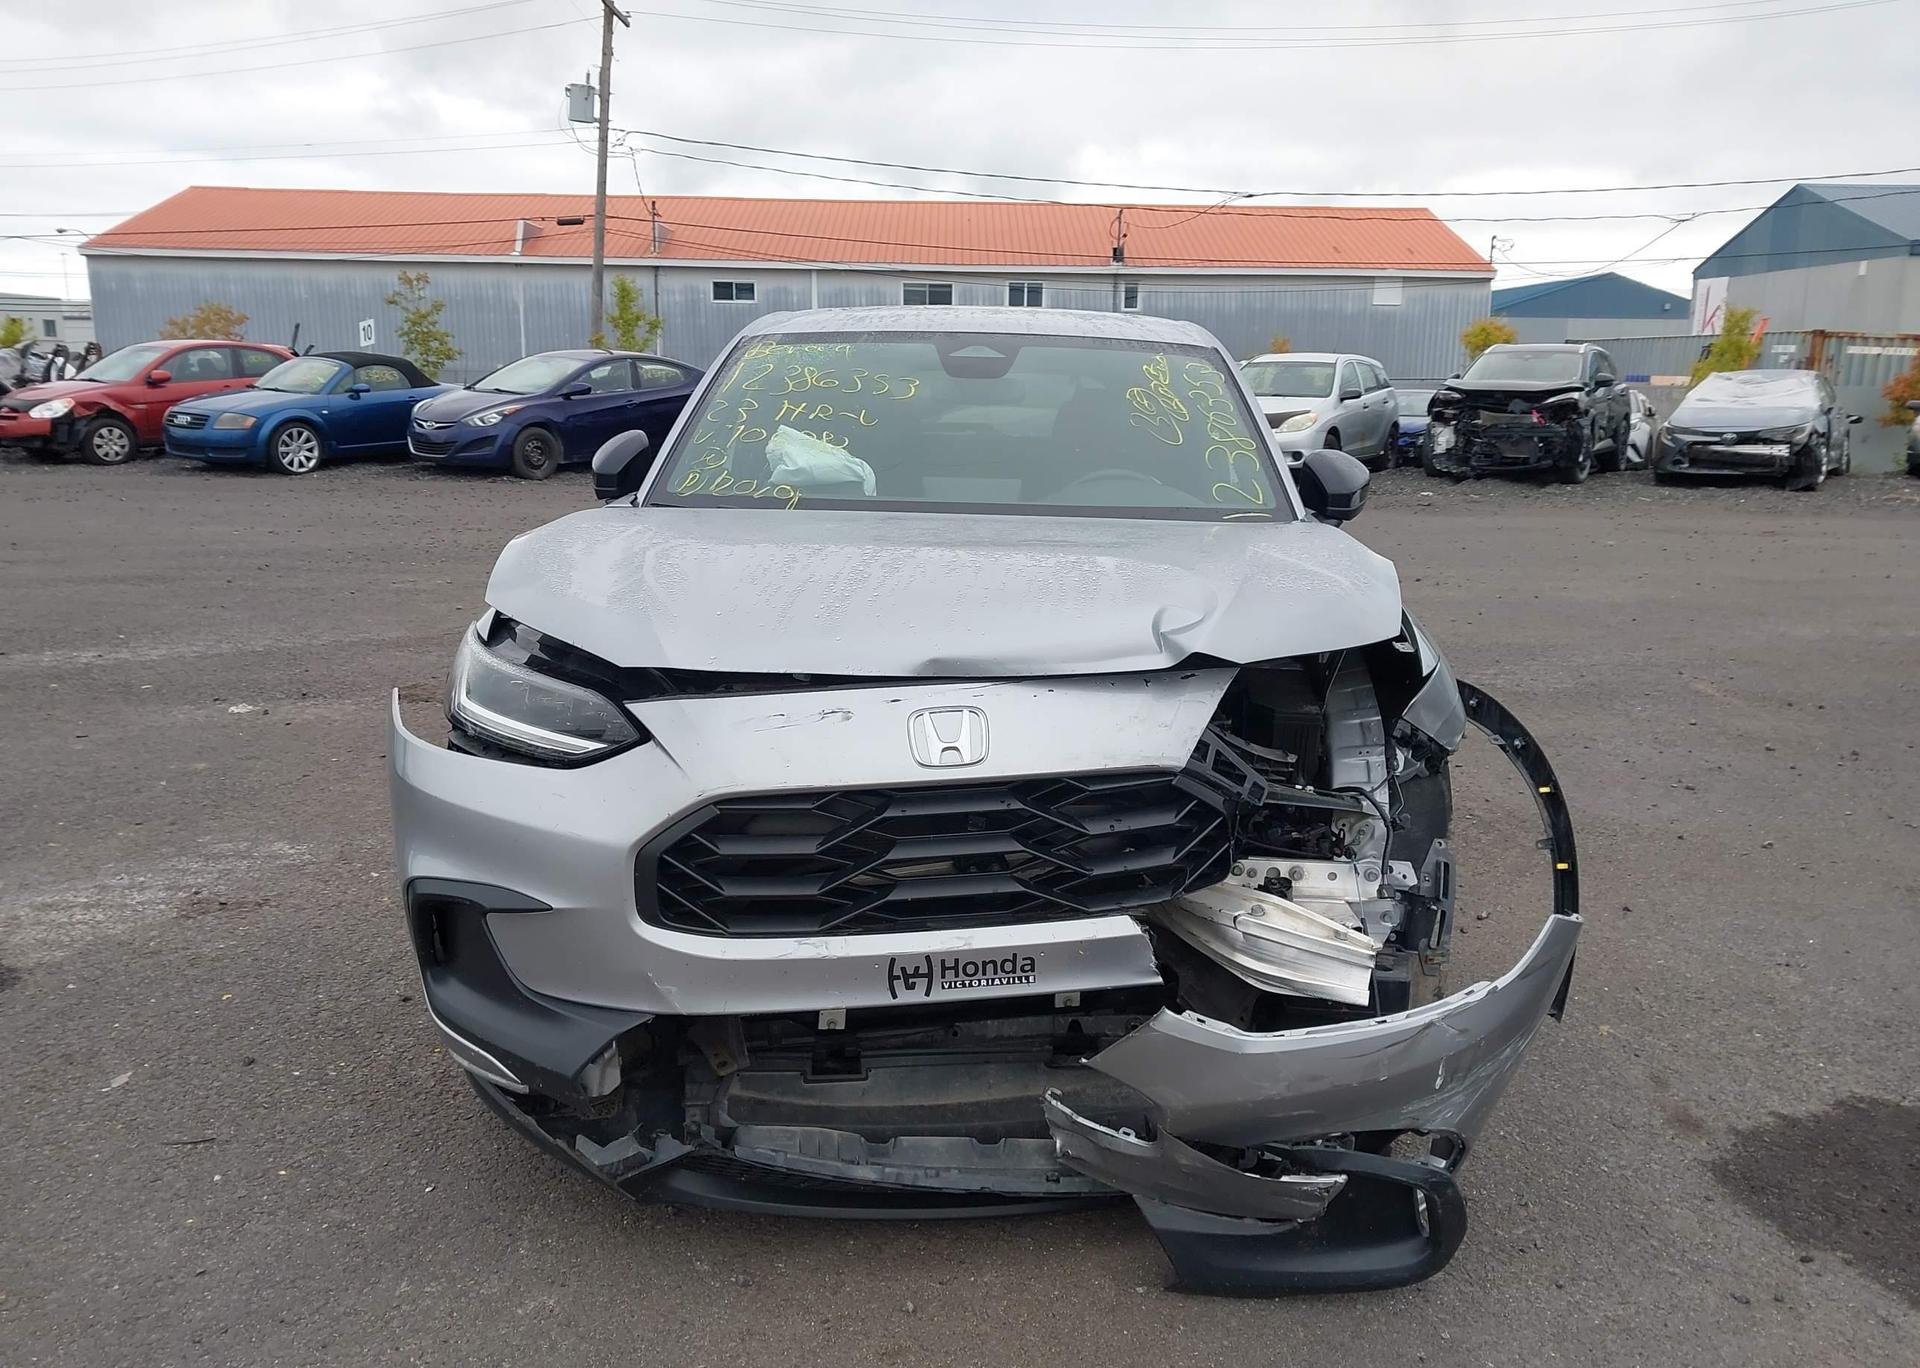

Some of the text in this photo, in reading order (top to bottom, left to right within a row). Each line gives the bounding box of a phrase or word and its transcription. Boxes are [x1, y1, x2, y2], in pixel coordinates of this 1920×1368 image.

[361, 324, 373, 342] 10
[706, 398, 758, 423] 23
[940, 952, 1036, 979] Honda
[942, 975, 1036, 989] VICTORIAVILLE
